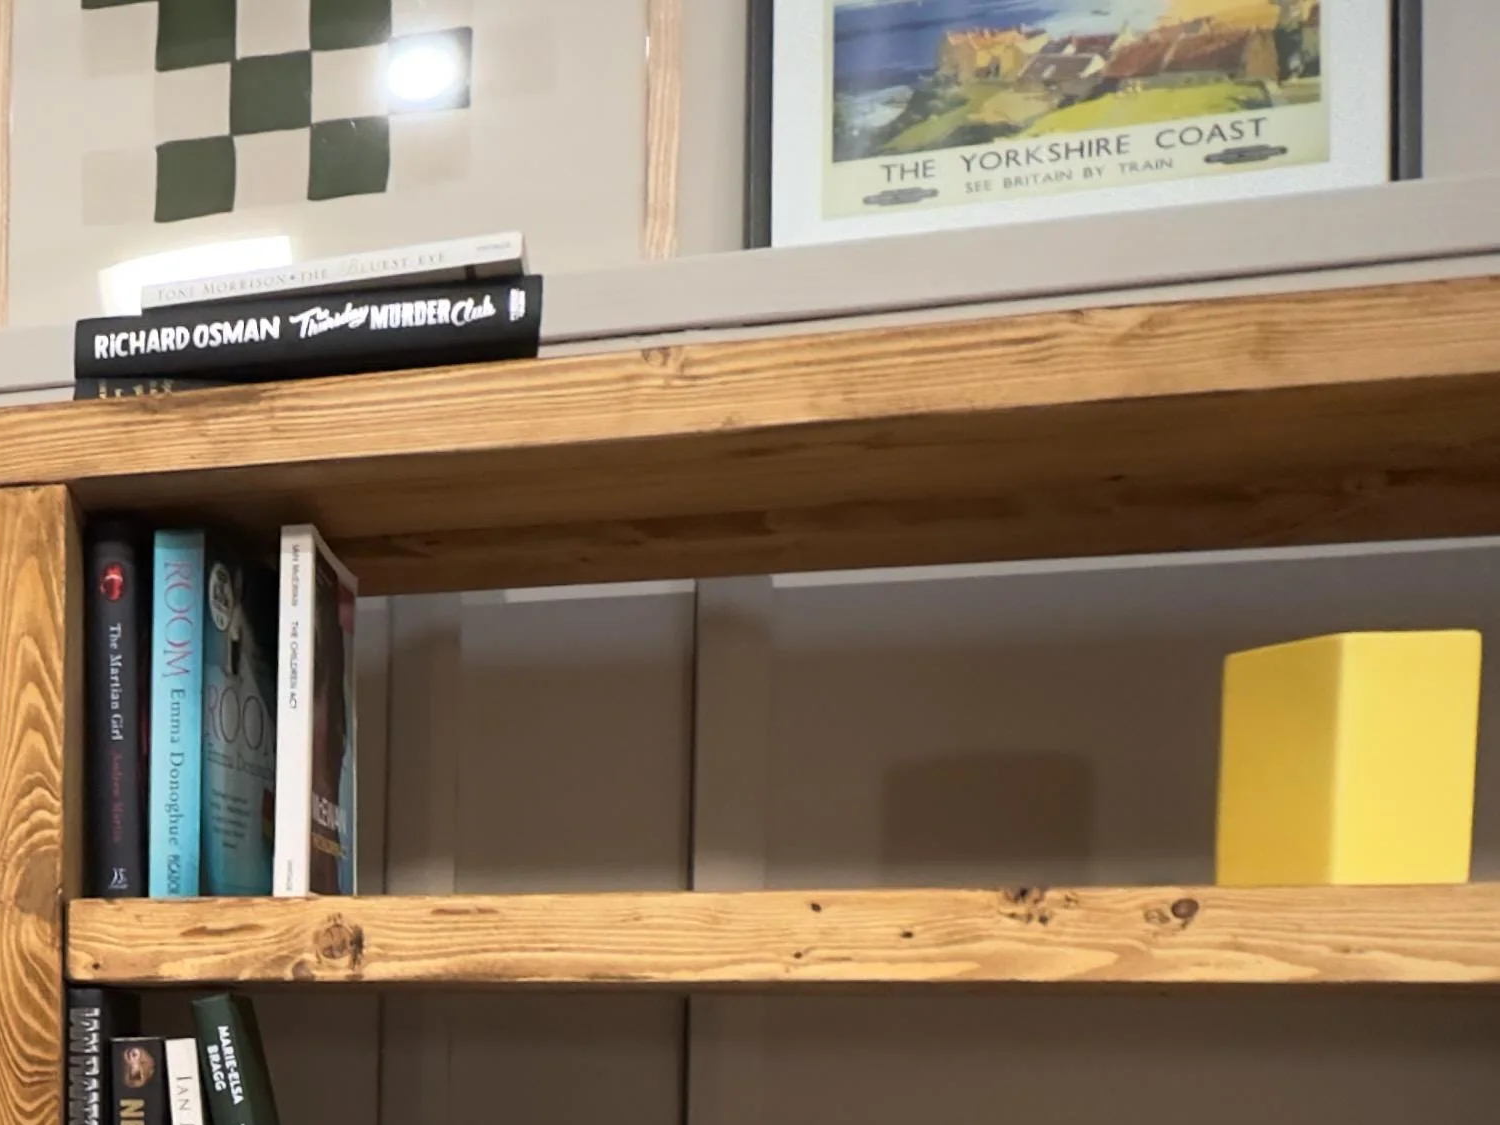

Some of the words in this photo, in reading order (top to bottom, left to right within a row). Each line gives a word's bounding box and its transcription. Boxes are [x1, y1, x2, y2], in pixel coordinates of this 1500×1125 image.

[880, 159, 937, 183] THE
[960, 133, 1131, 173] YORKSHIRE
[1155, 117, 1268, 150] COAST
[964, 179, 994, 194] SEE
[1002, 168, 1074, 189] BRITAIN
[1083, 166, 1105, 180] BY
[1118, 157, 1174, 175] TRAIN
[202, 273, 288, 296] MORRISON
[94, 325, 191, 360] RICHARD
[192, 315, 281, 349] OSMAN
[368, 298, 451, 330] MURDER
[450, 294, 497, 327] Club
[108, 622, 122, 650] The
[161, 559, 194, 679] ROOM
[290, 621, 300, 638] THE
[109, 654, 123, 710] Martian
[288, 692, 298, 710] ACT
[111, 713, 124, 741] Girl
[170, 688, 186, 744] Emma
[164, 752, 185, 847] Donoghue
[206, 1044, 227, 1092] BRAGG
[217, 1025, 245, 1105] MARIE-ELSA
[175, 1075, 192, 1112] IAN
